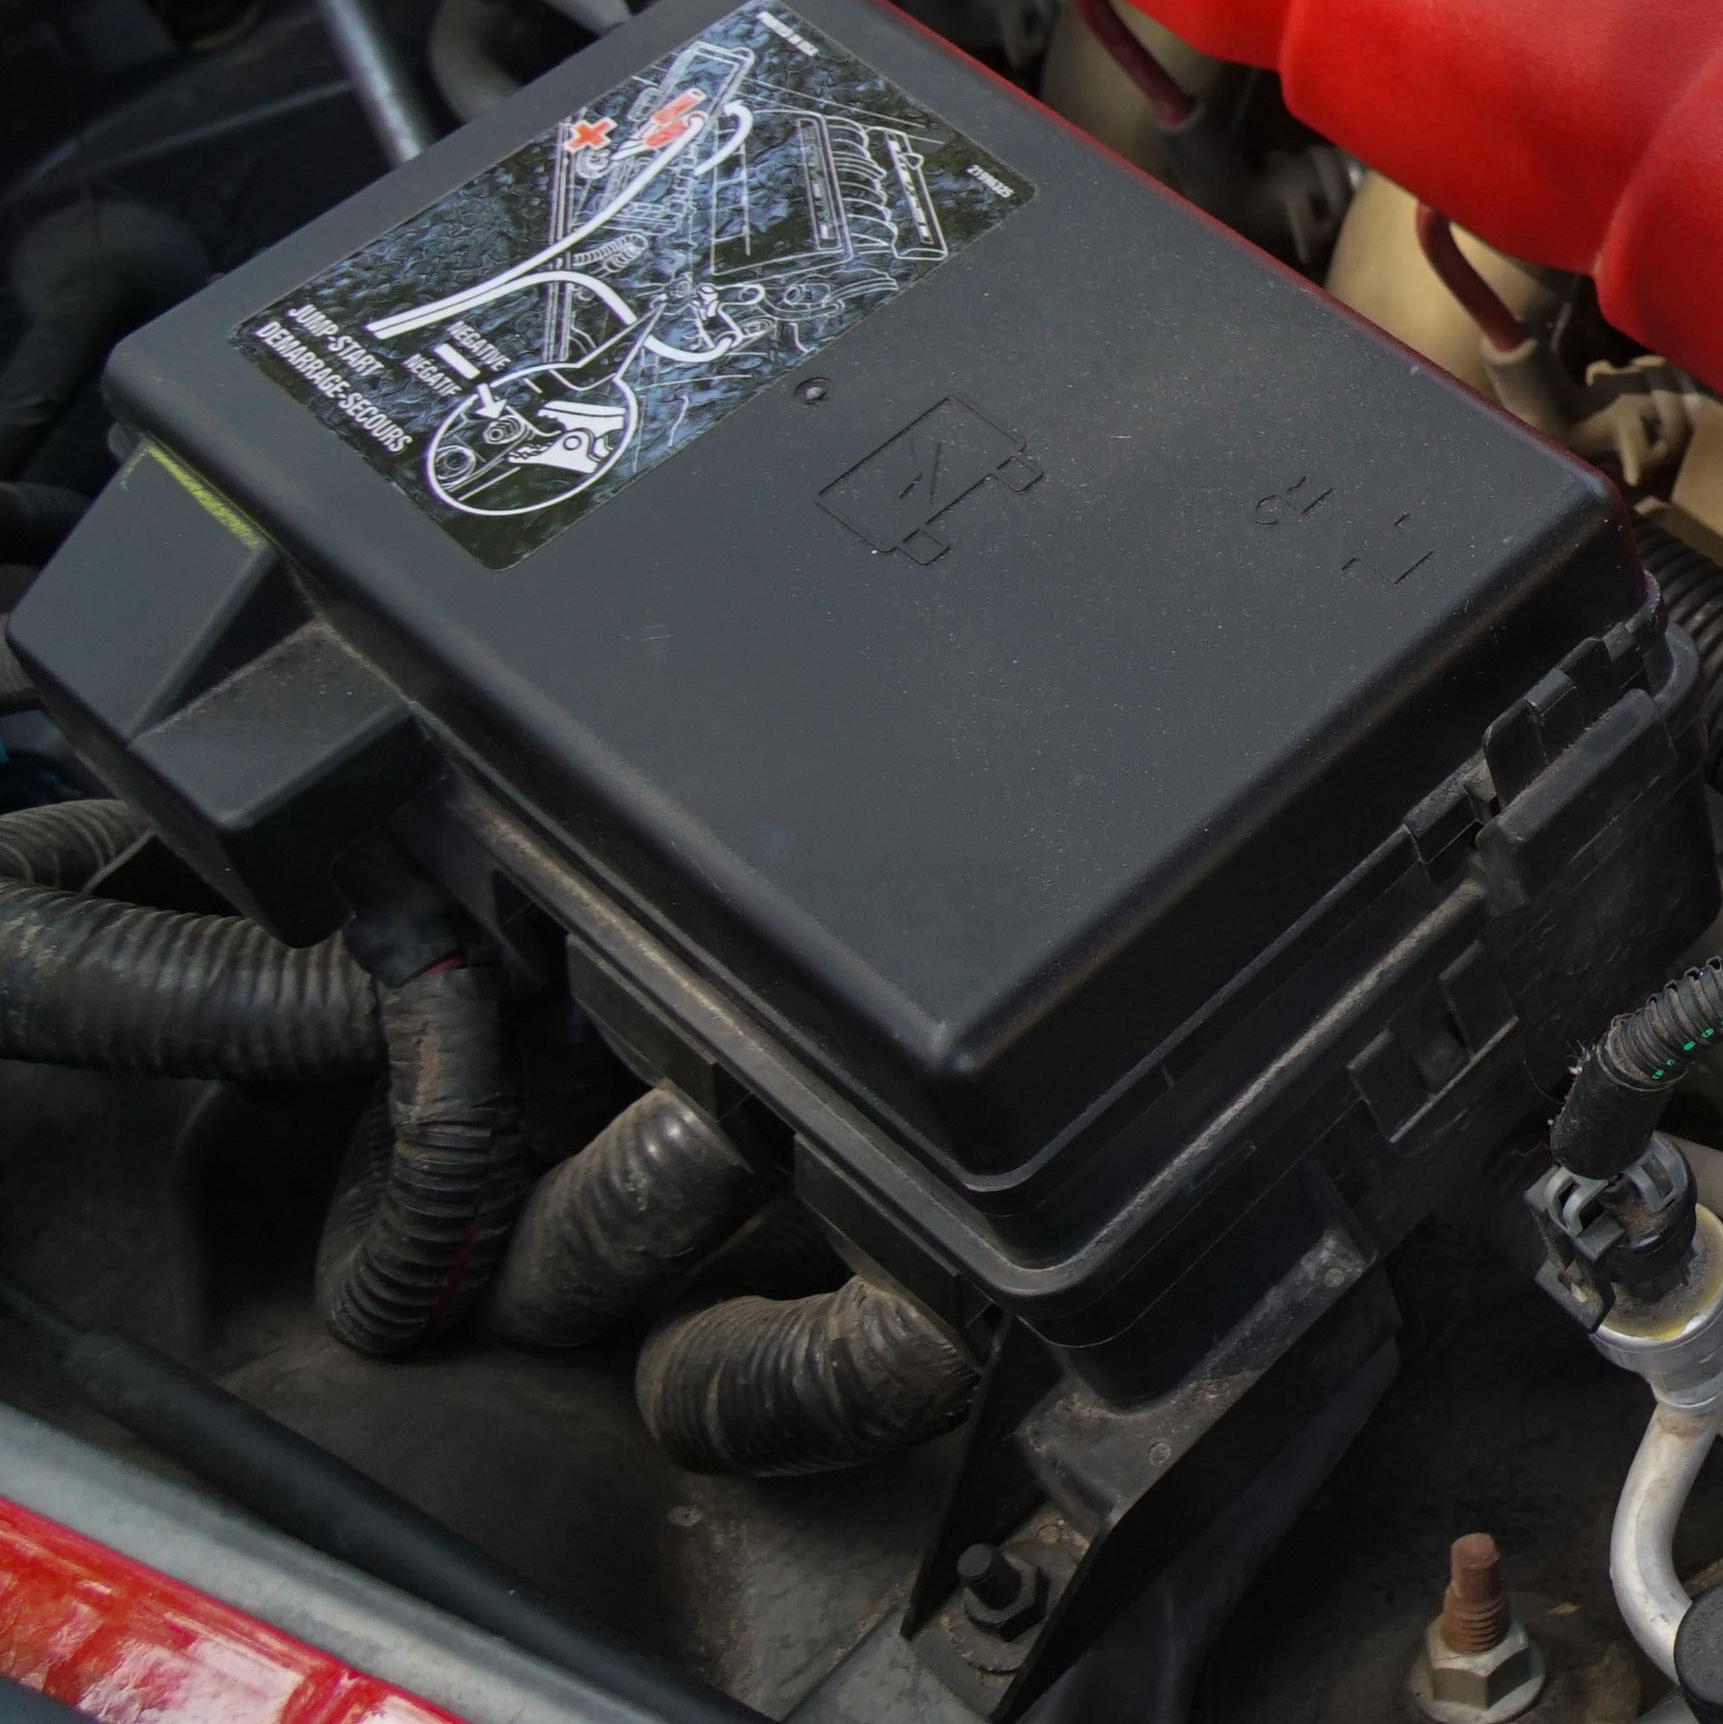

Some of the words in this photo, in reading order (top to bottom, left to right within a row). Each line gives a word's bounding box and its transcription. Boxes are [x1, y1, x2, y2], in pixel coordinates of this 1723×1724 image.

[287, 303, 385, 377] JUMP-START
[447, 320, 512, 372] NEGATIVE
[253, 321, 414, 453] DEMARRAGE-SECOURS
[402, 353, 462, 397] NÉGATIF
